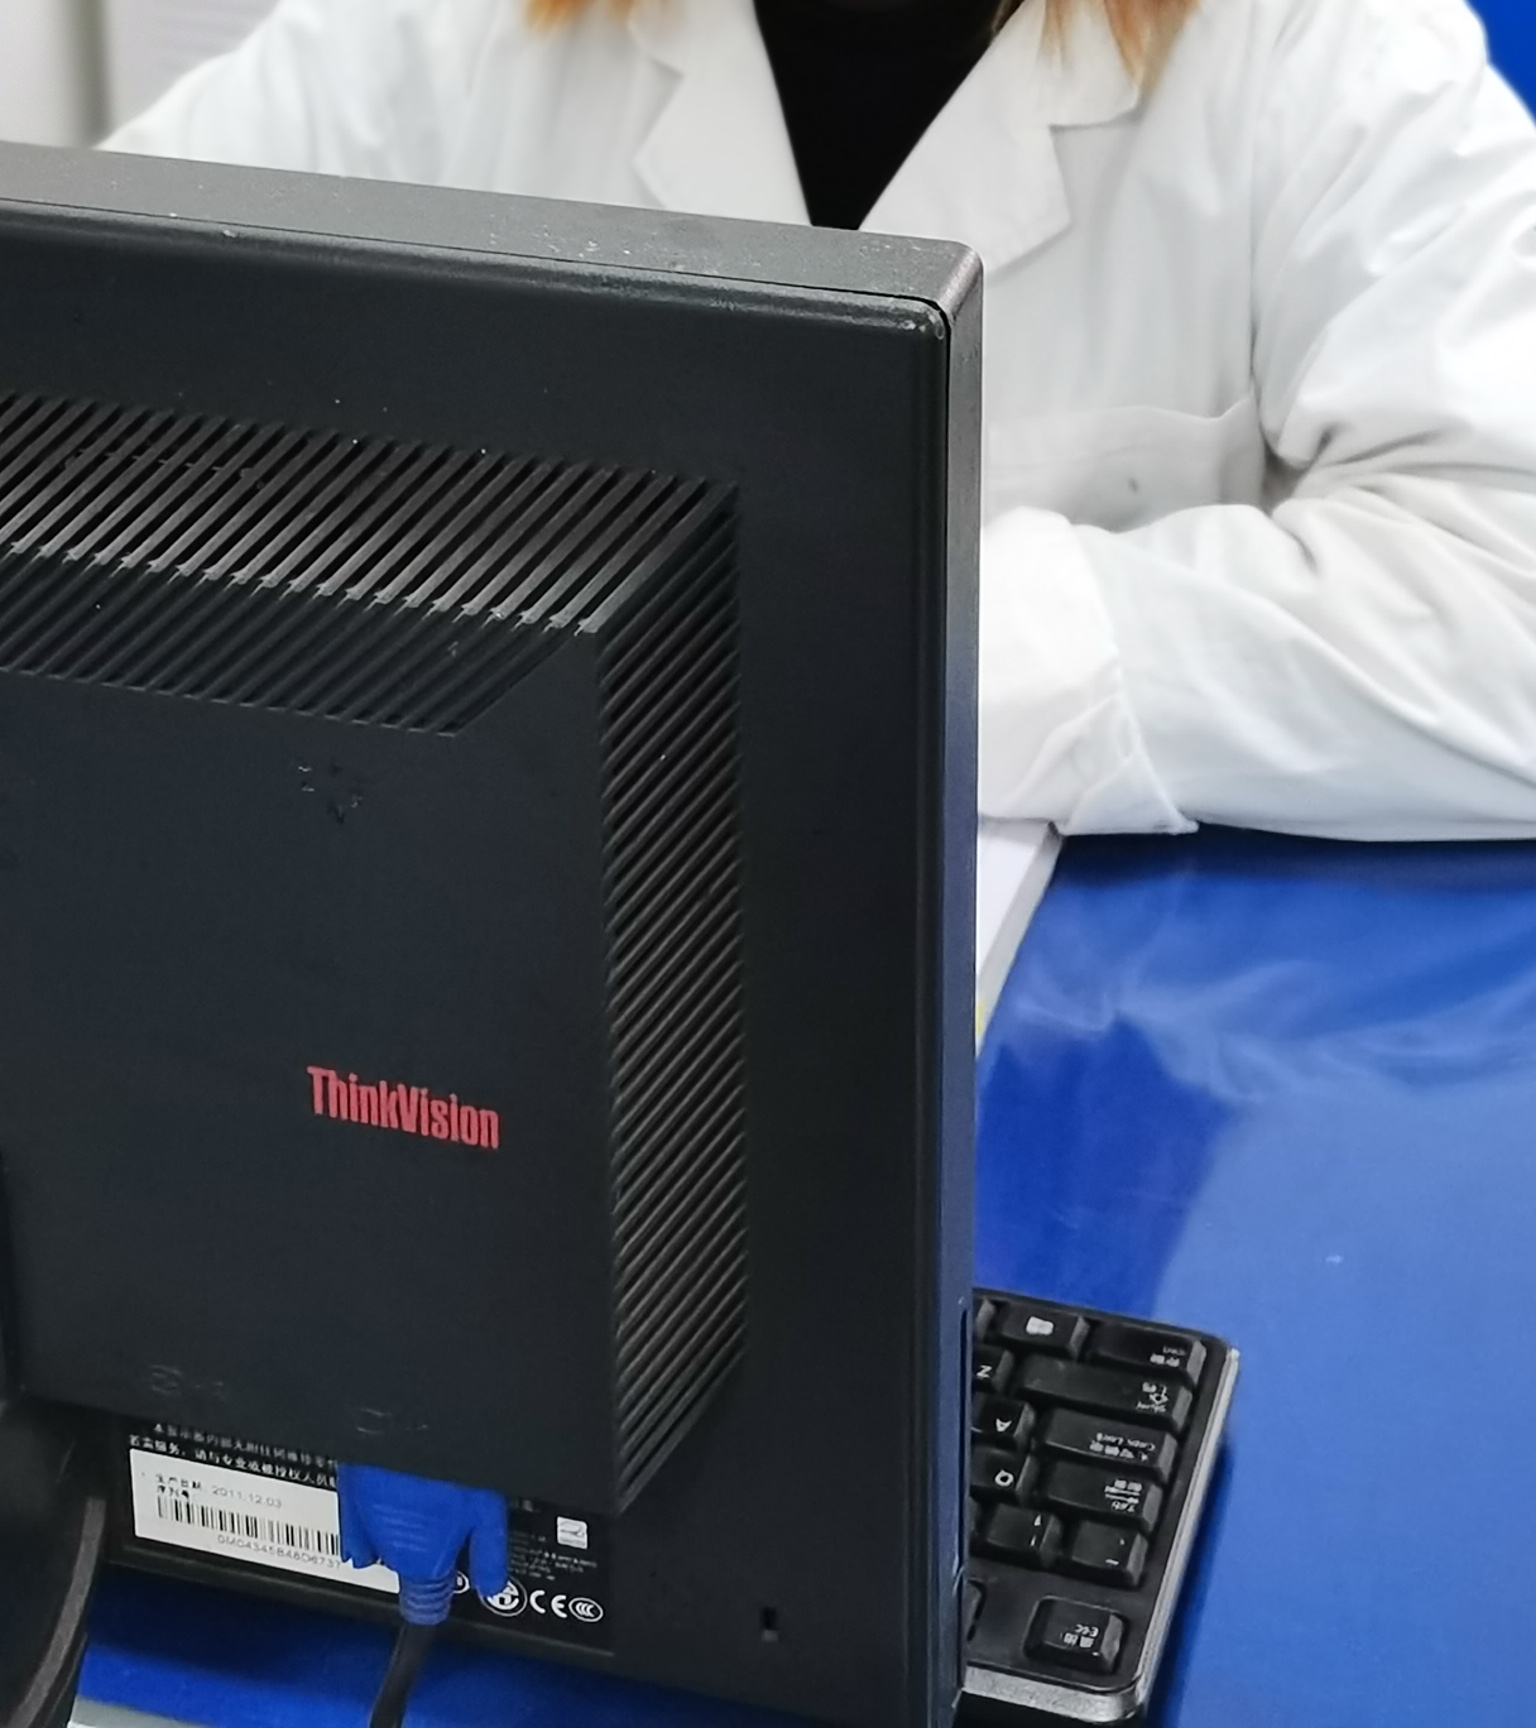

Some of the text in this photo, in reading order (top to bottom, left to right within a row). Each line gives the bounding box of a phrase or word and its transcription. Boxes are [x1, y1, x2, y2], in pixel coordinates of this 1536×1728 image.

[306, 1065, 500, 1150] ThinkVision
[976, 1364, 992, 1378] Z
[995, 1417, 1013, 1433] A
[995, 1469, 1015, 1488] Q
